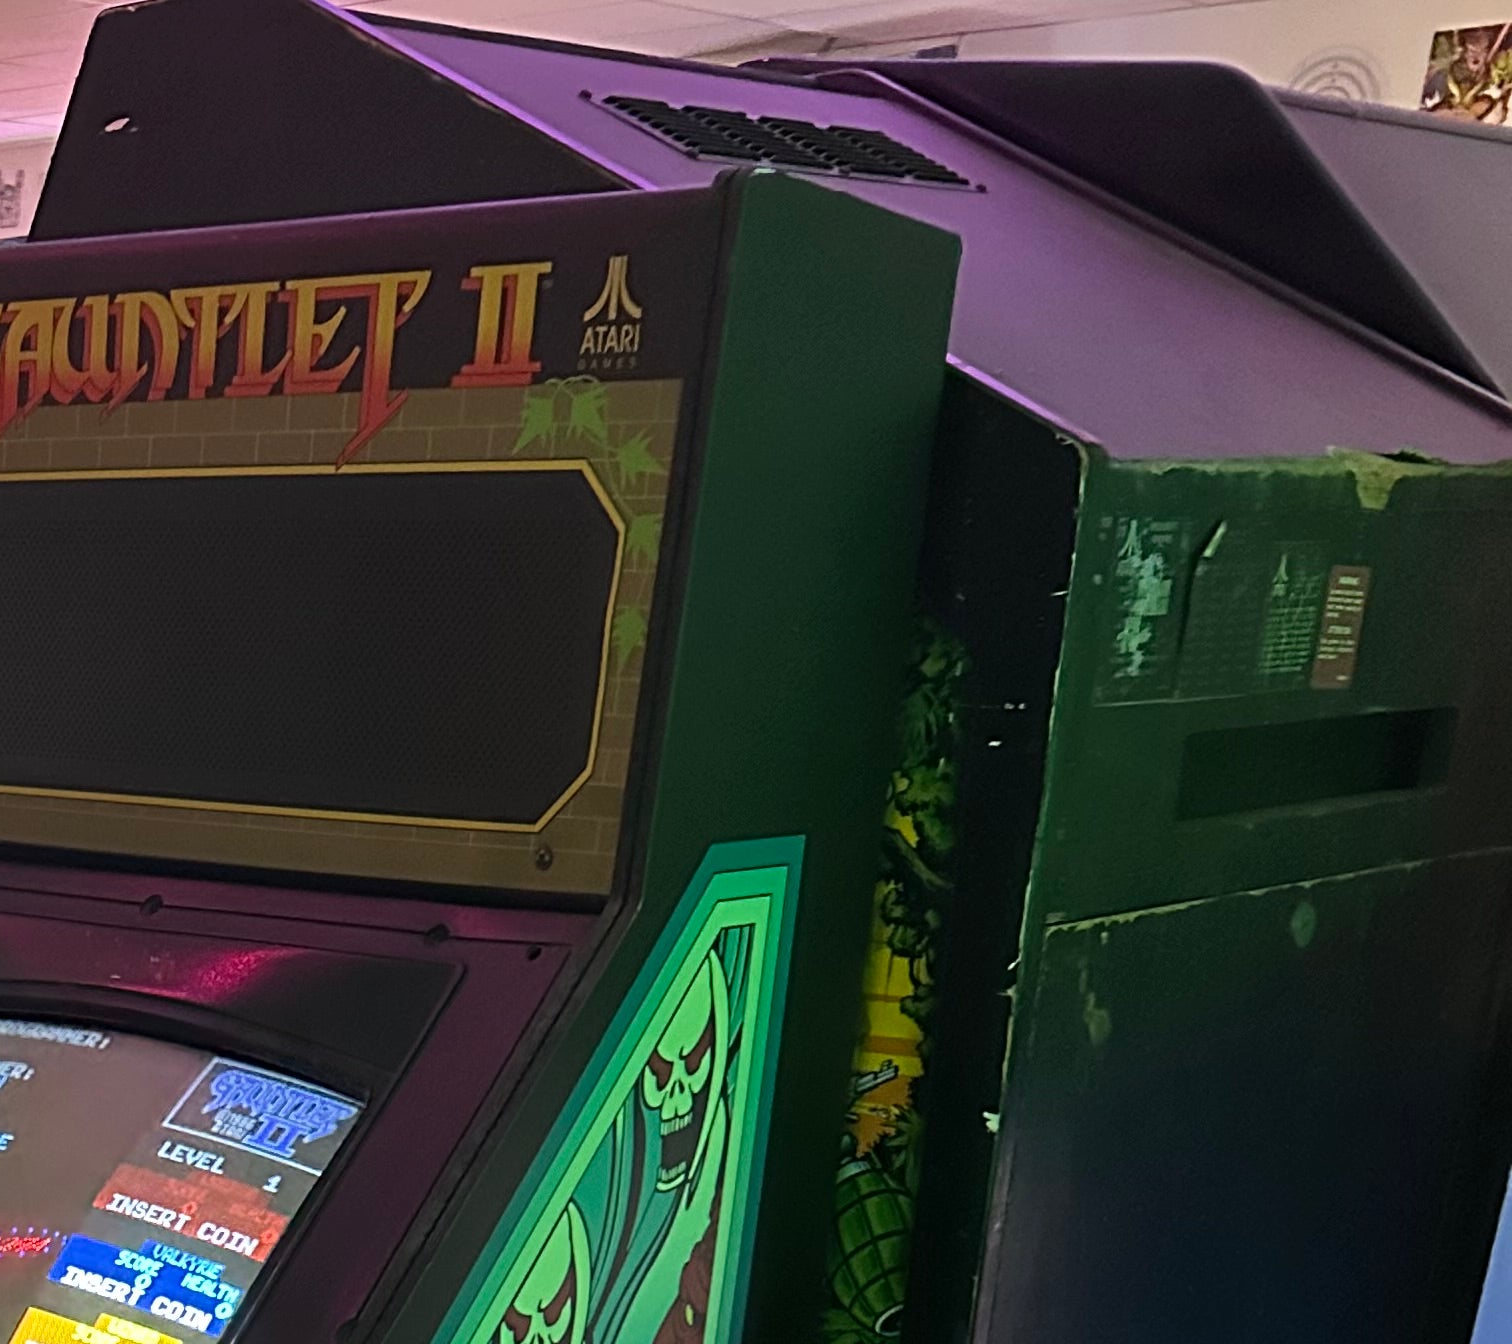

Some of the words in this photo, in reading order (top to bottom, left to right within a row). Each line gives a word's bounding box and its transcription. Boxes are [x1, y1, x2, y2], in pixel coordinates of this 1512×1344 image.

[451, 261, 553, 387] II
[579, 324, 642, 355] ATARI
[157, 1140, 224, 1174] LEVEL
[262, 1174, 282, 1194] 1
[105, 1191, 192, 1233] INSERT
[196, 1221, 261, 1257] COIN
[114, 1249, 165, 1278] SCORE
[180, 1272, 241, 1304] HEALTH
[152, 1243, 227, 1281] VALKYRIE
[60, 1265, 146, 1307] INSERT
[150, 1295, 214, 1333] COIN
